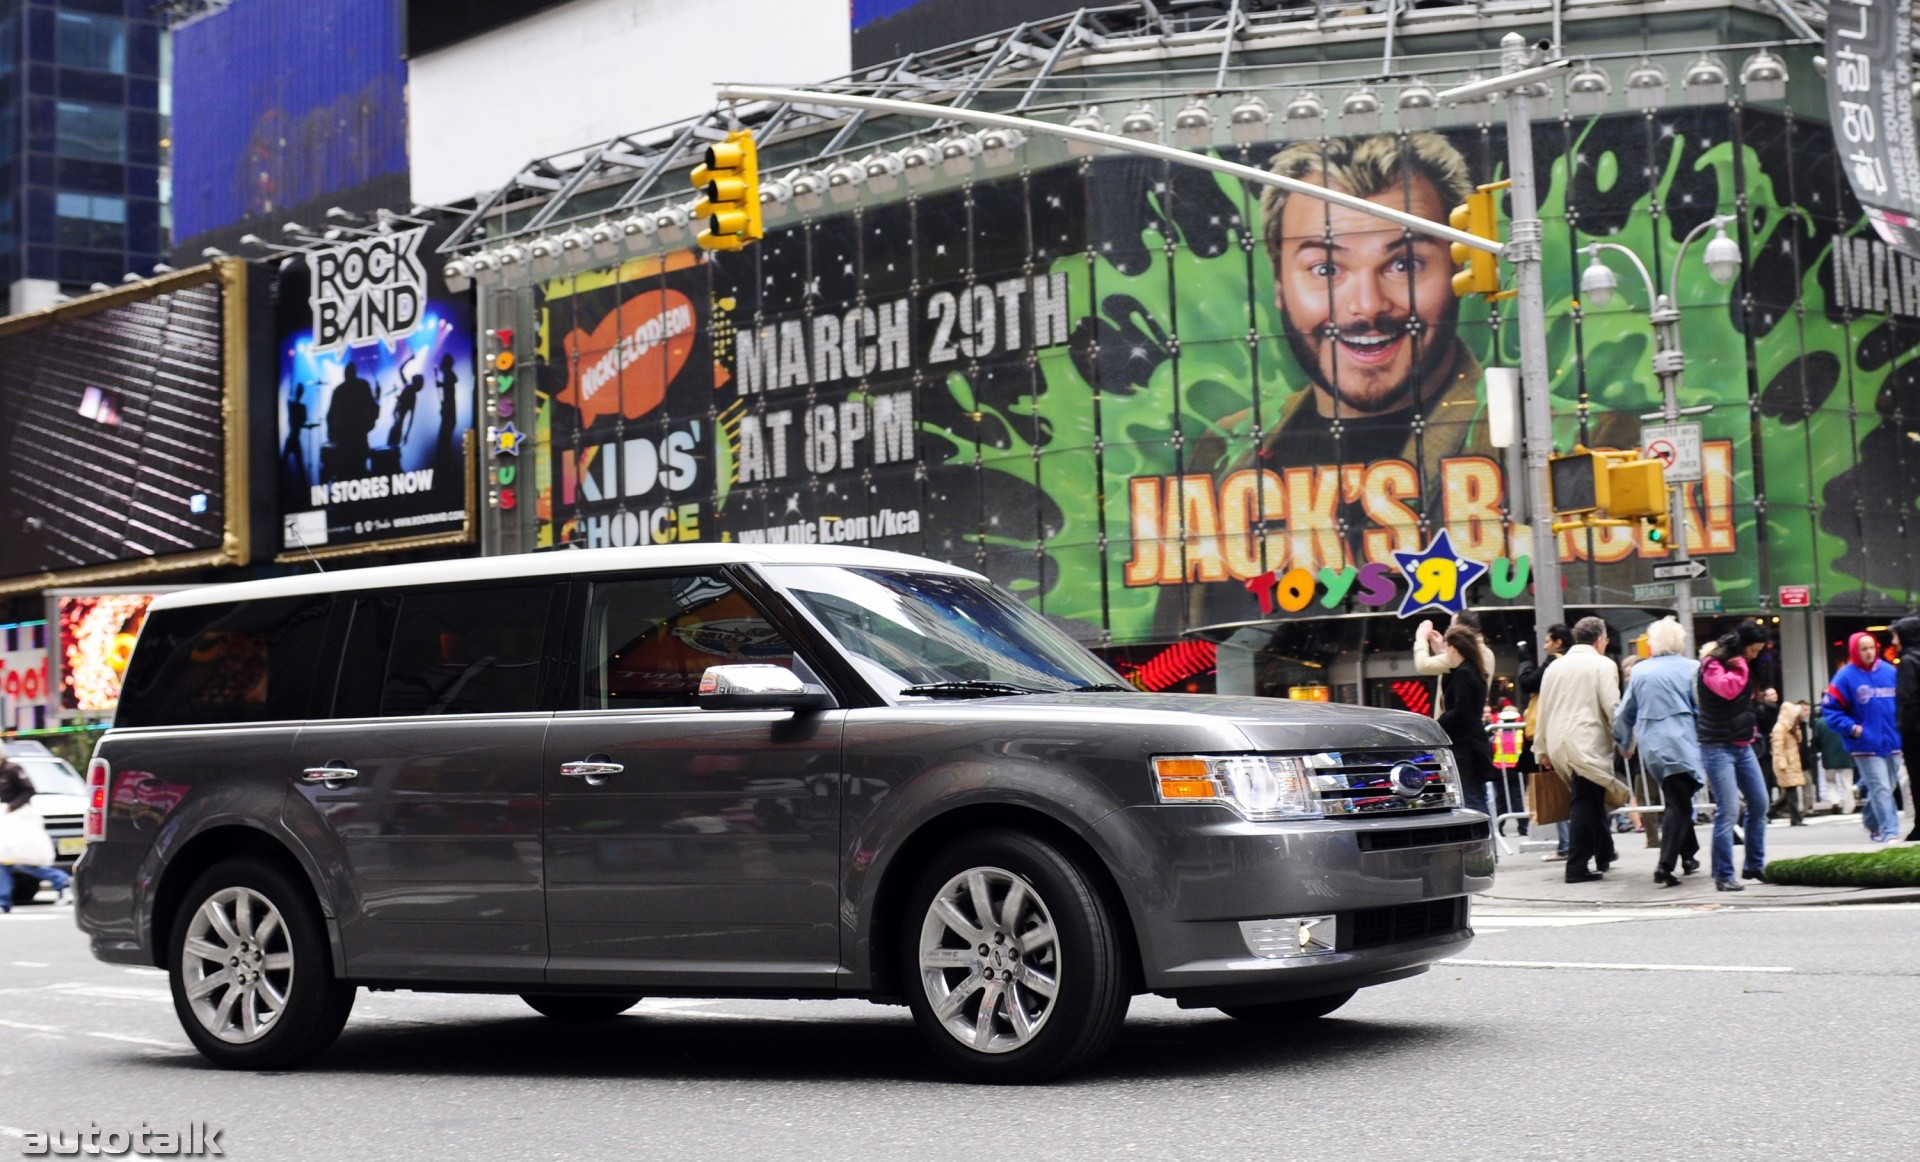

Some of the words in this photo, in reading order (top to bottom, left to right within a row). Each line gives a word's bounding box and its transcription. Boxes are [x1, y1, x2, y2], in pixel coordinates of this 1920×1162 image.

[1881, 69, 1900, 143] SQUARE
[1896, 57, 1912, 86] OF
[1887, 146, 1911, 200] TIMES
[316, 230, 422, 303] ROCK
[317, 283, 421, 348] BAND
[736, 299, 910, 395] MARCH
[928, 272, 1069, 364] 29TH
[581, 304, 692, 401] NICKELODEON
[562, 420, 701, 506] KIDS'
[738, 410, 793, 483] AT
[804, 391, 915, 475] 8PM
[311, 485, 329, 506] IN
[331, 475, 390, 504] STORES
[391, 468, 434, 496] NOW
[1124, 460, 1422, 586] JACK'S
[561, 503, 701, 549] CHOICE
[1244, 561, 1396, 615] TOYS
